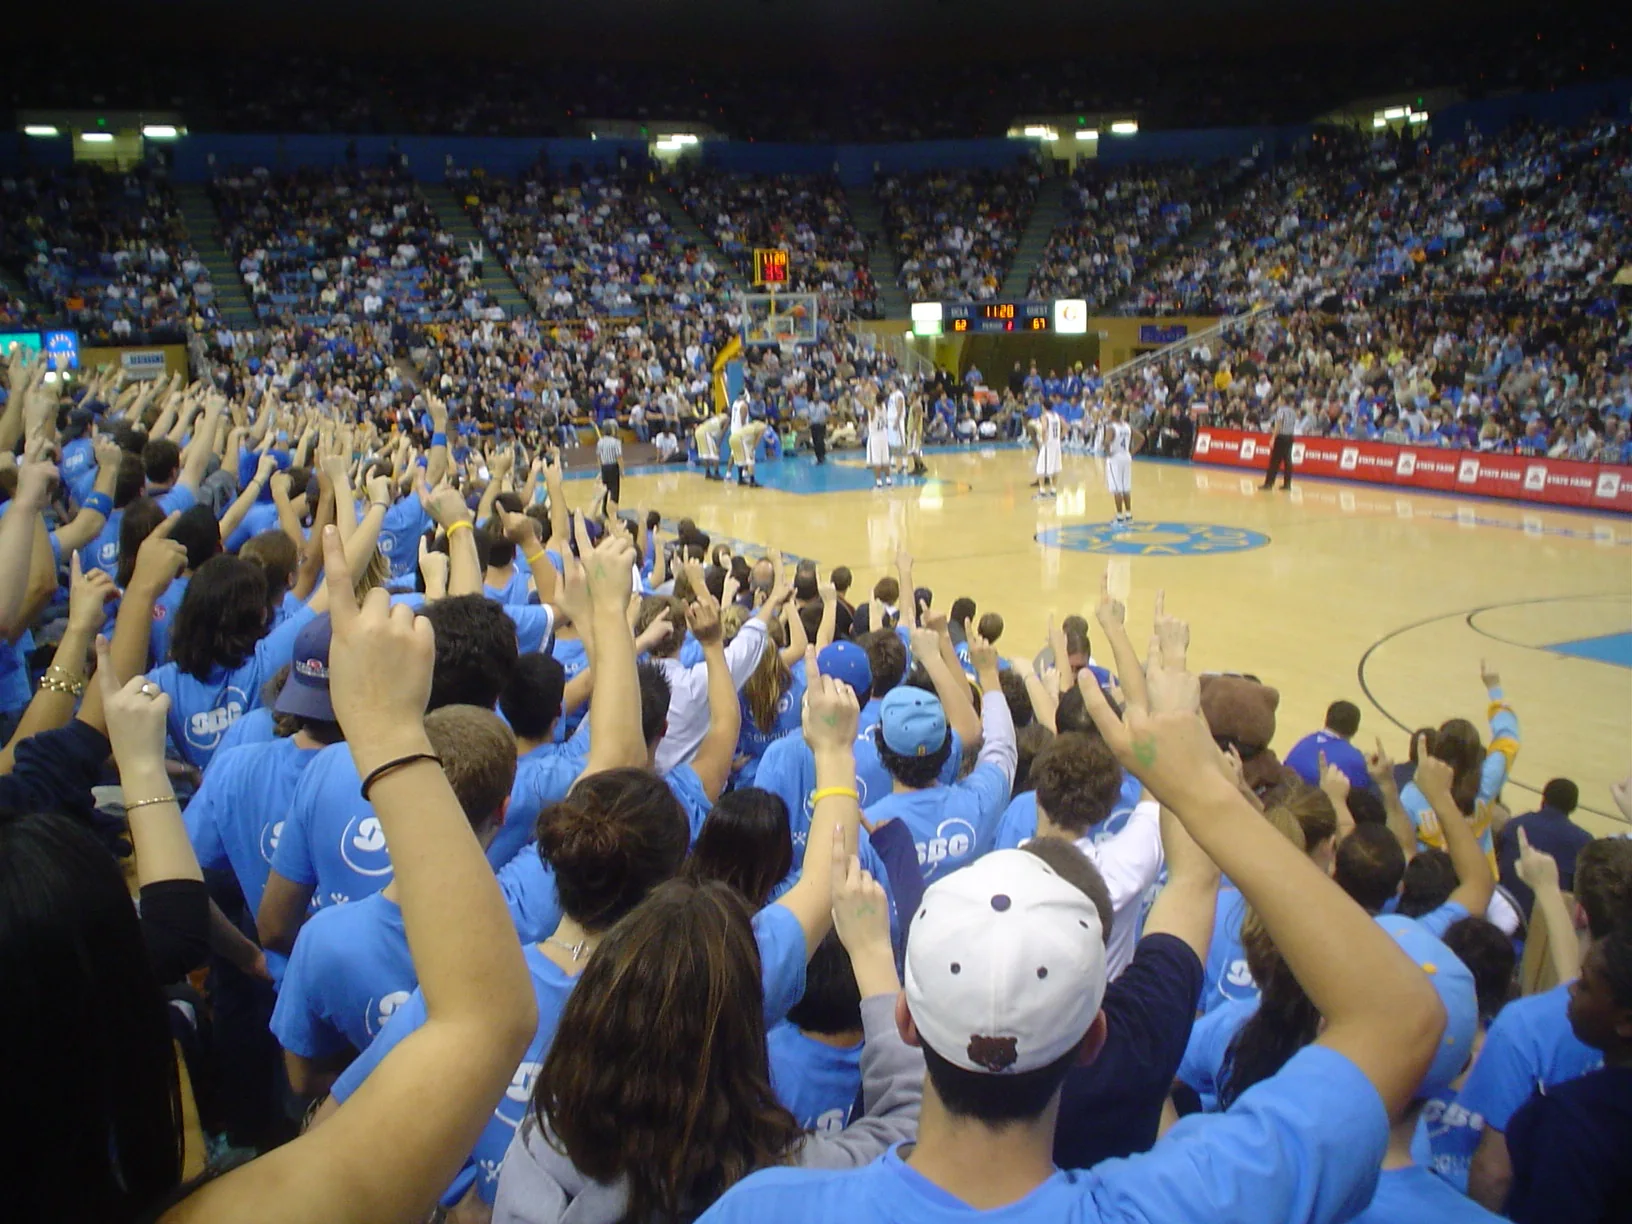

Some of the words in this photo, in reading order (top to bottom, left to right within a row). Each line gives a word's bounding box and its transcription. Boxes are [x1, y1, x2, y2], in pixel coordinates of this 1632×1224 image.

[954, 319, 968, 331] 62
[1032, 317, 1046, 330] 67
[1416, 461, 1435, 472] STATE
[1436, 462, 1455, 474] FARM
[1479, 468, 1499, 480] STATE
[1500, 469, 1520, 482] FARM
[1547, 475, 1568, 486] STATE
[1569, 476, 1592, 489] FARM
